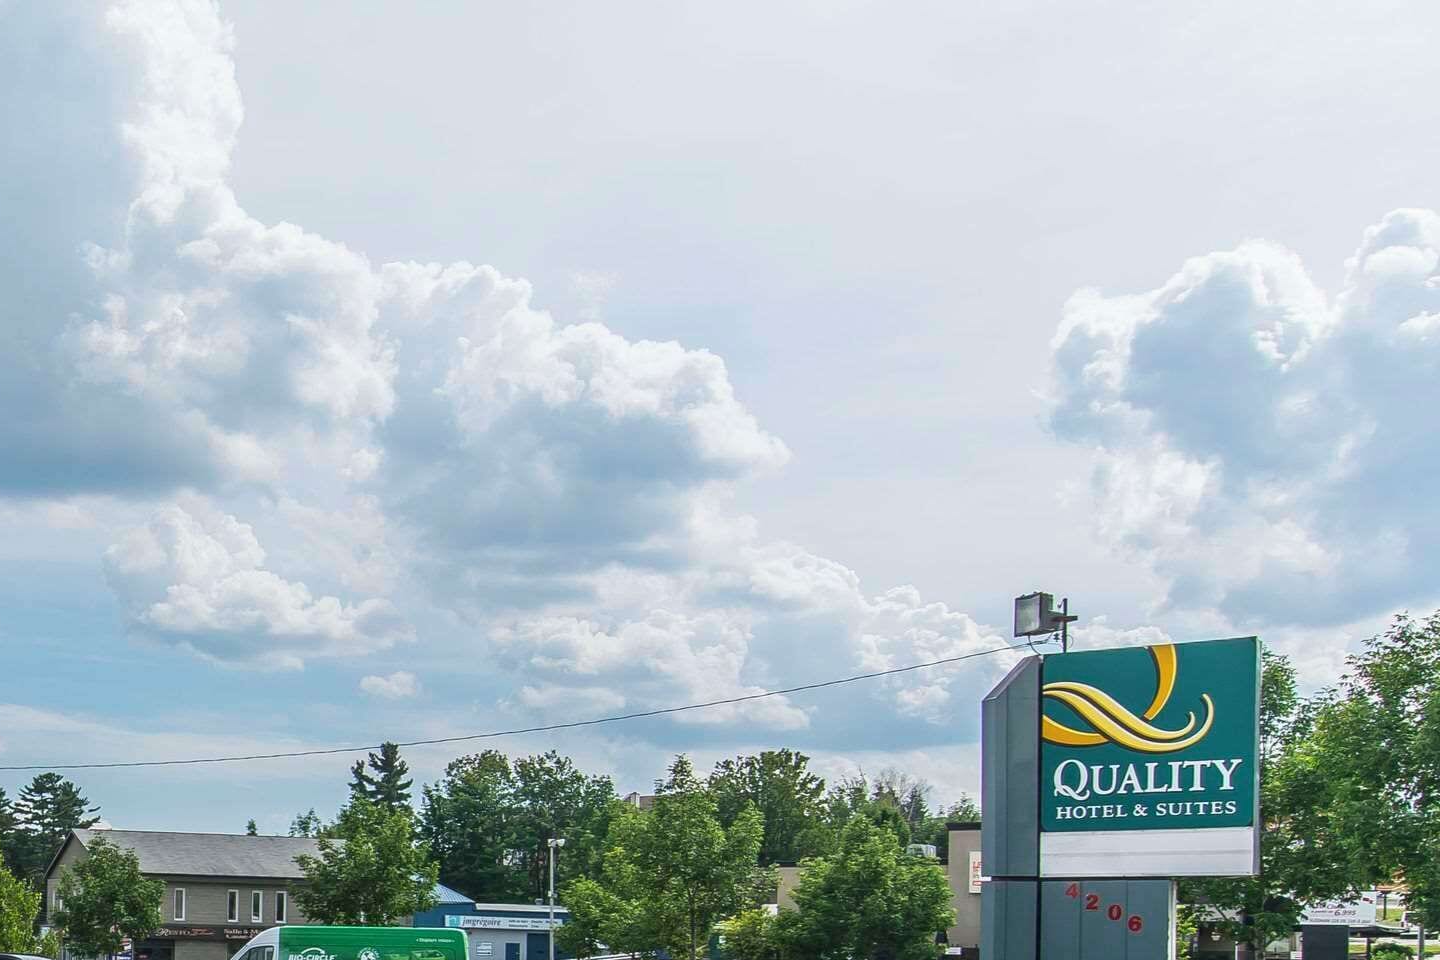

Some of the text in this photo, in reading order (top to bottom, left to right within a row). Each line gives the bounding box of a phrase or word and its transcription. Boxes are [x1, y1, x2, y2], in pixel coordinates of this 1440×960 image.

[1053, 758, 1242, 801] QUALITY
[1055, 801, 1237, 820] HOTEL & SUITES
[1065, 882, 1143, 933] 4206
